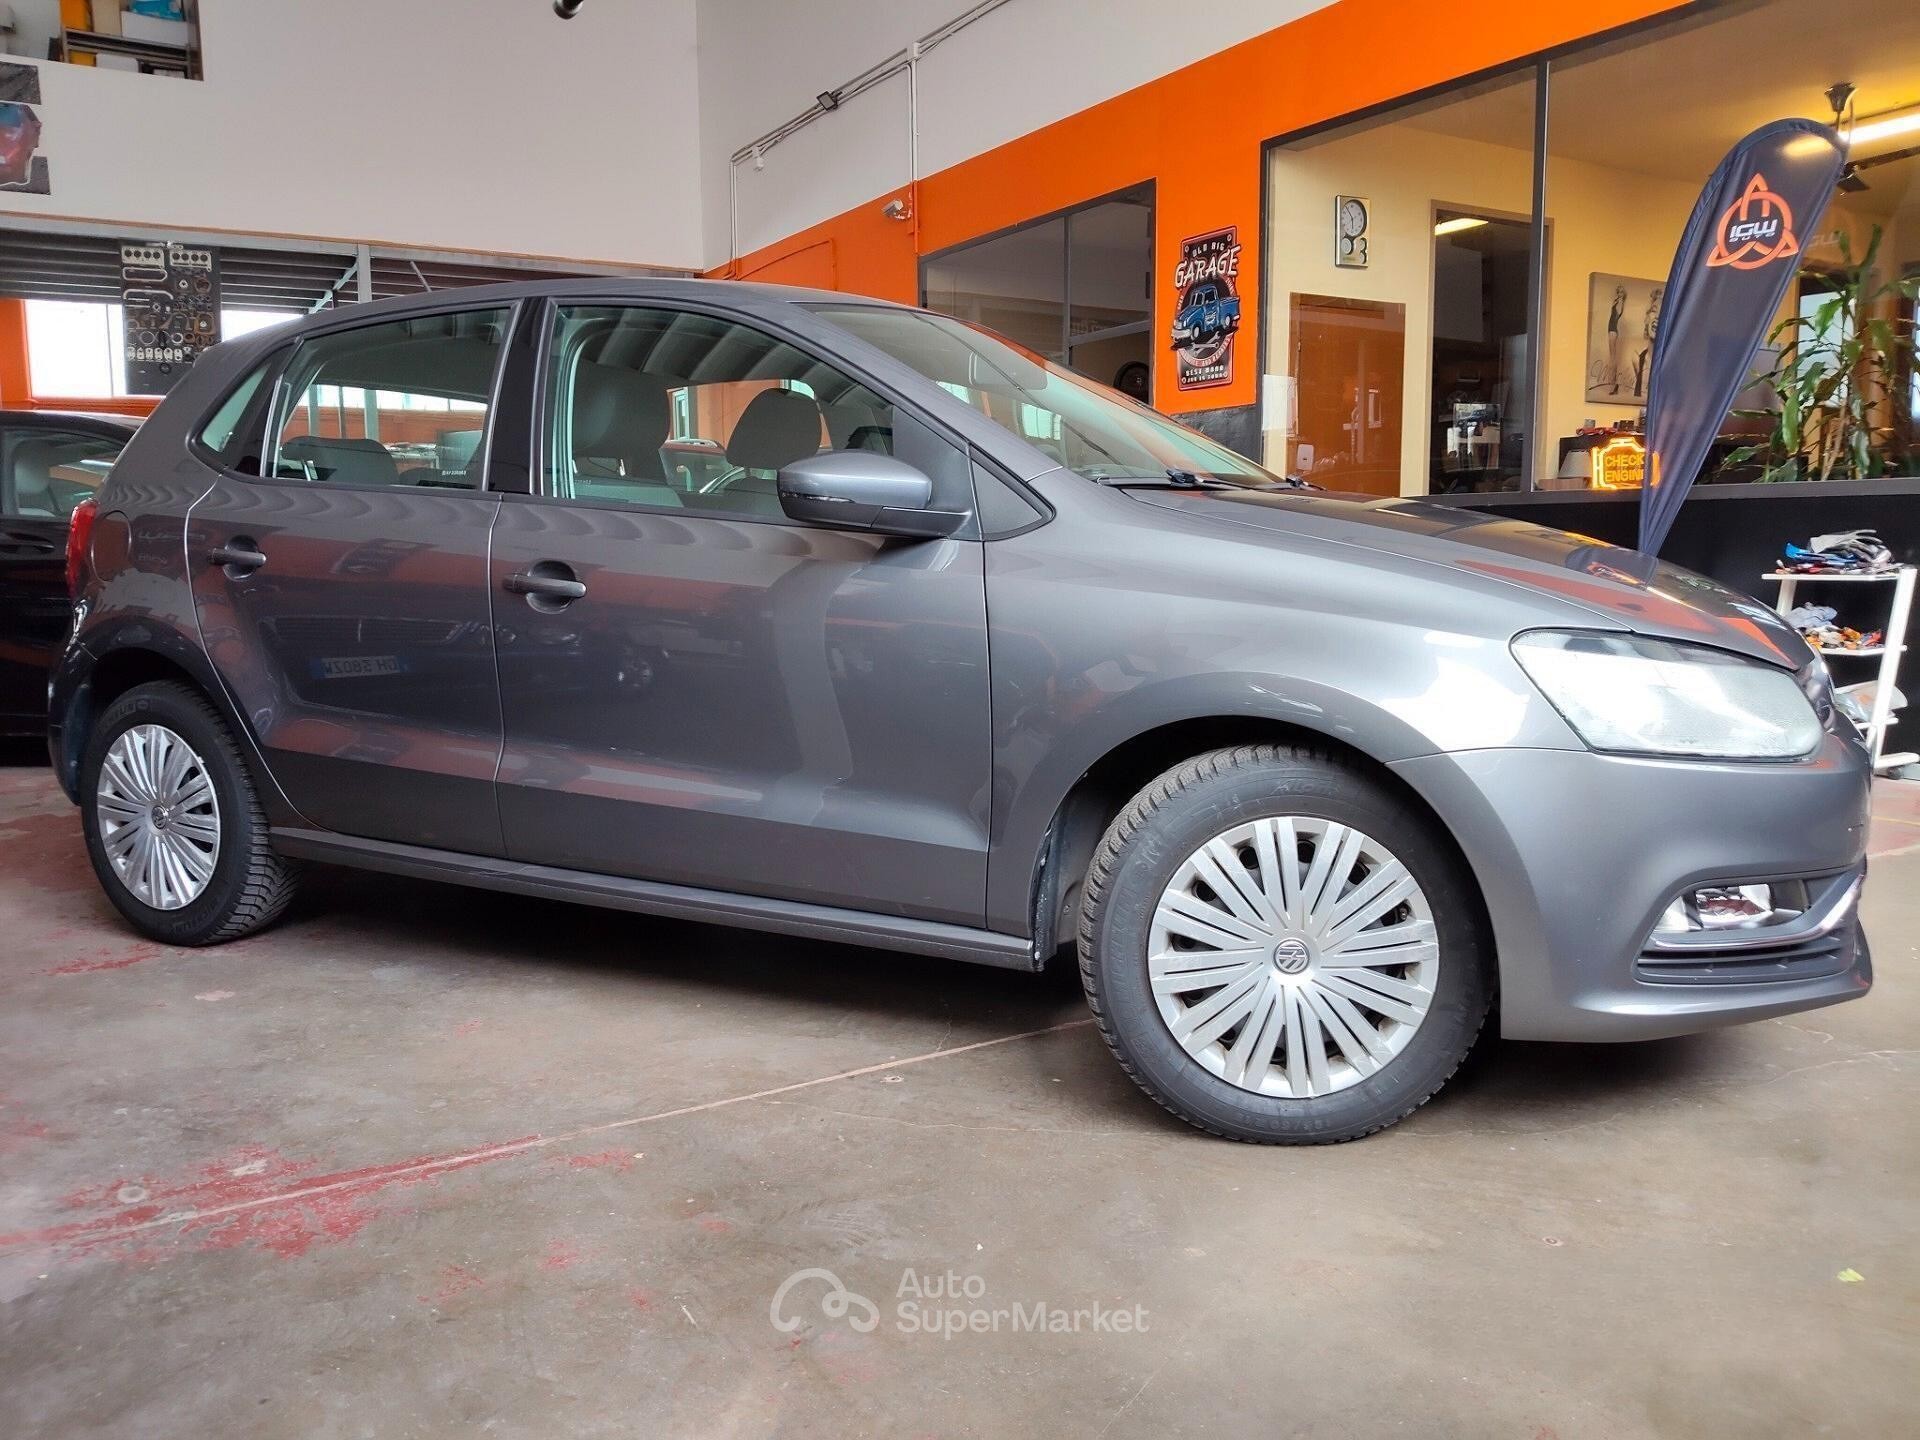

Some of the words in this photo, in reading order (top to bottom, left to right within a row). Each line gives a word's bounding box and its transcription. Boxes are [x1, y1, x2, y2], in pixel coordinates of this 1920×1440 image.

[1729, 219, 1779, 239] IGW
[1211, 242, 1225, 251] BIG
[1175, 245, 1241, 288] GARAGE
[1605, 453, 1645, 467] CHECK
[1605, 469, 1644, 482] ENGIN
